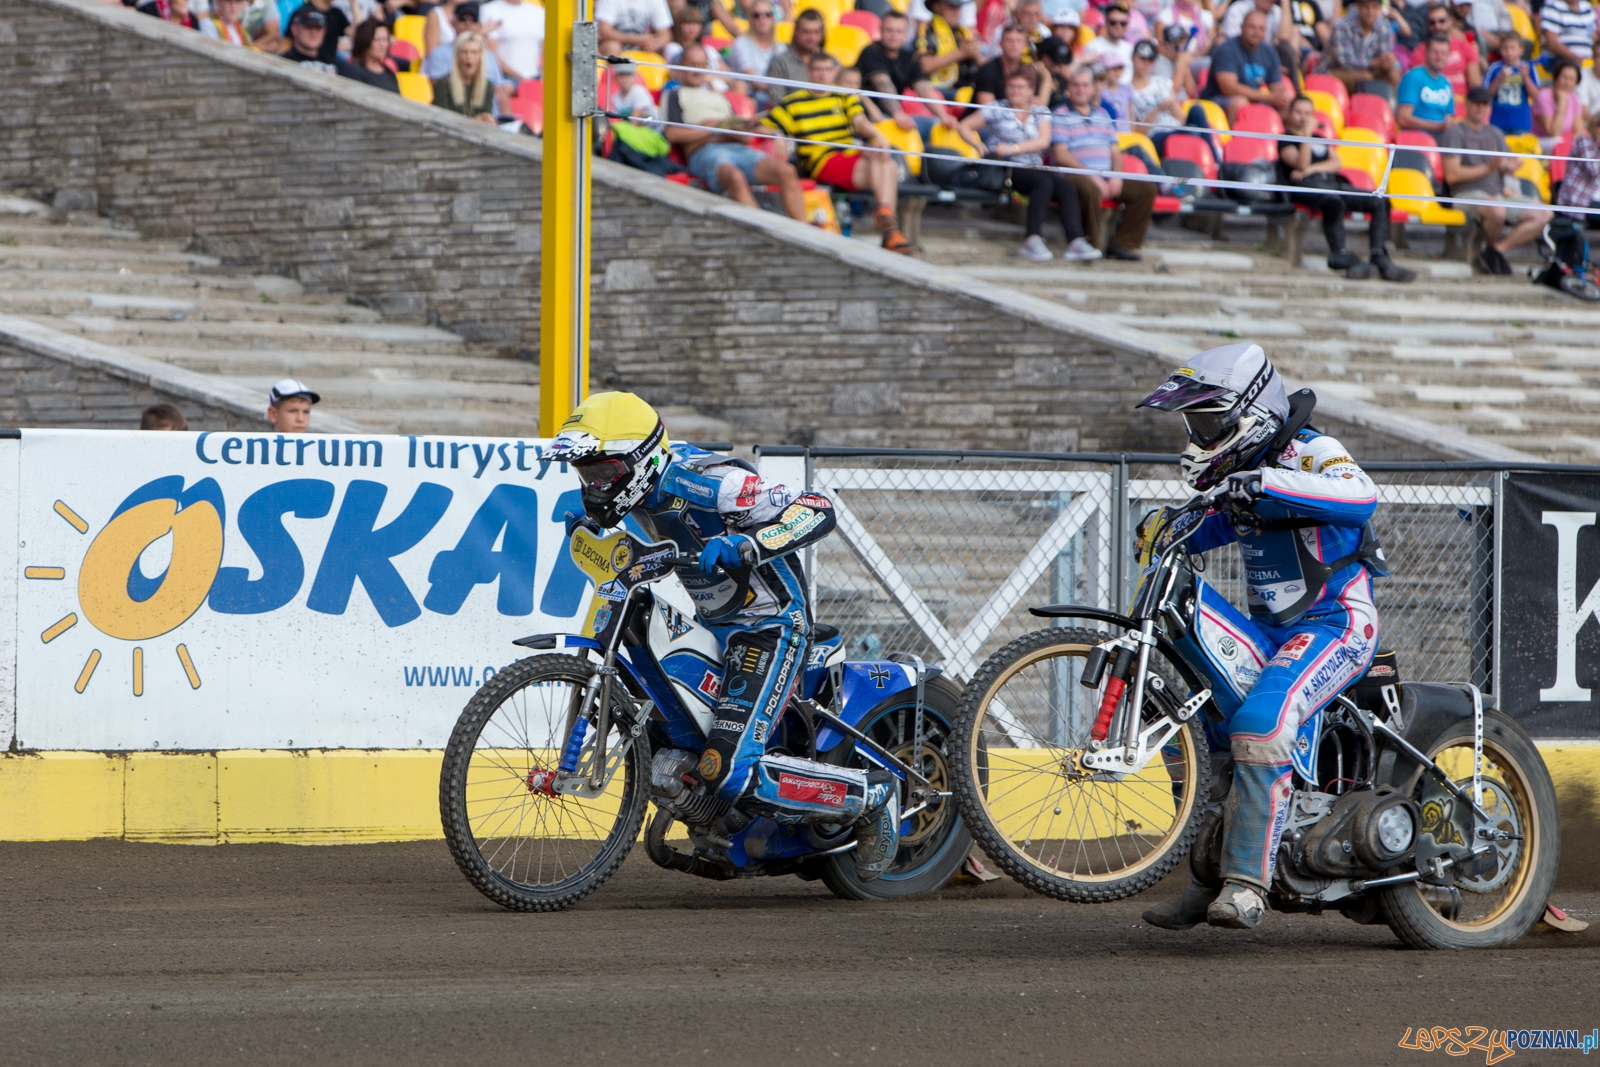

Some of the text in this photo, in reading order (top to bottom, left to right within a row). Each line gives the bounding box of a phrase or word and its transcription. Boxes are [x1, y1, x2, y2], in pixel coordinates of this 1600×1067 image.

[195, 430, 383, 468] Centrum
[761, 509, 812, 541] AGROMIX
[582, 543, 611, 574] LECHMA
[1246, 570, 1282, 581] ECHMA
[765, 646, 797, 717] POLCOPPER
